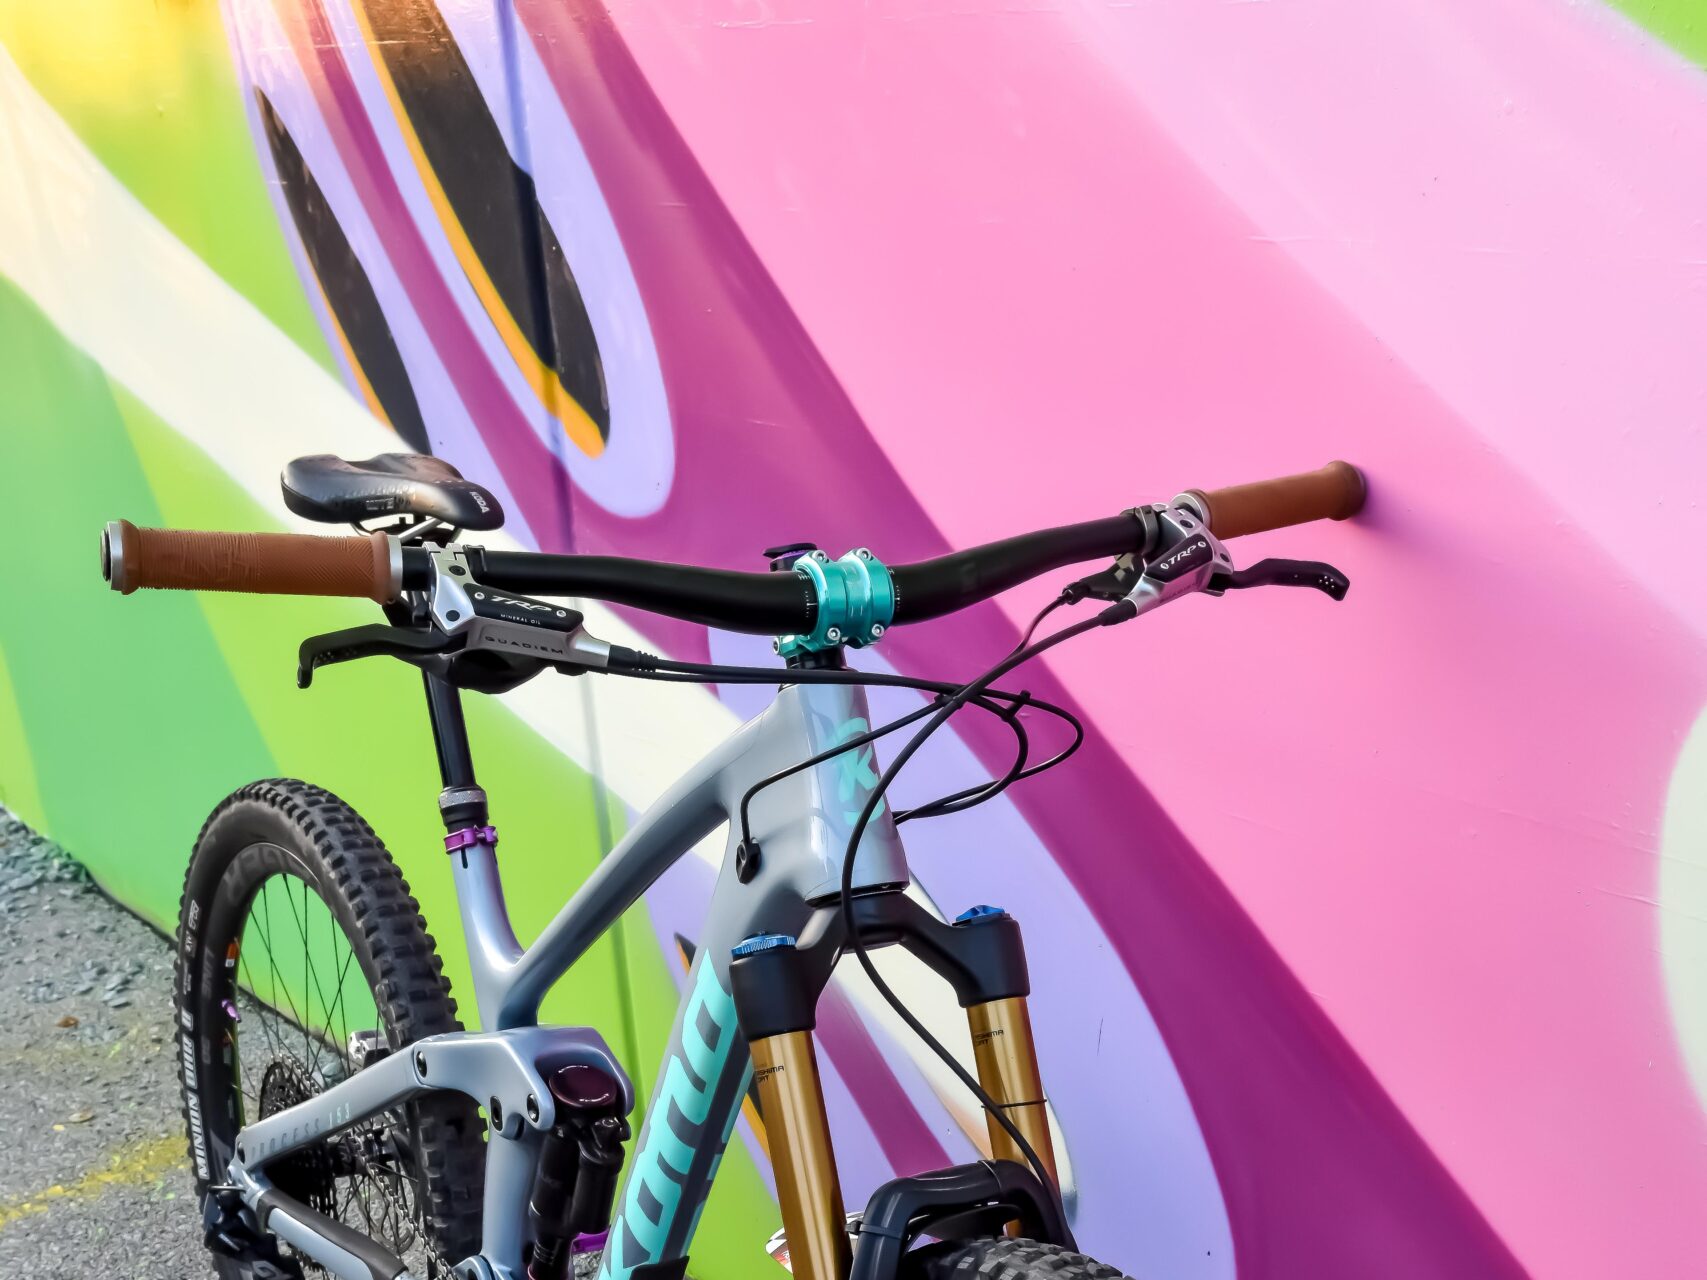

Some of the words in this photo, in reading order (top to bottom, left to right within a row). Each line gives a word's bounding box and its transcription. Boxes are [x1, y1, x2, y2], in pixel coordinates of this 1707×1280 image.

[1168, 544, 1197, 565] TRP
[491, 595, 553, 611] TRP
[501, 613, 528, 623] MINERAL
[485, 636, 564, 655] QUADIEM
[187, 1092, 210, 1180] MINION
